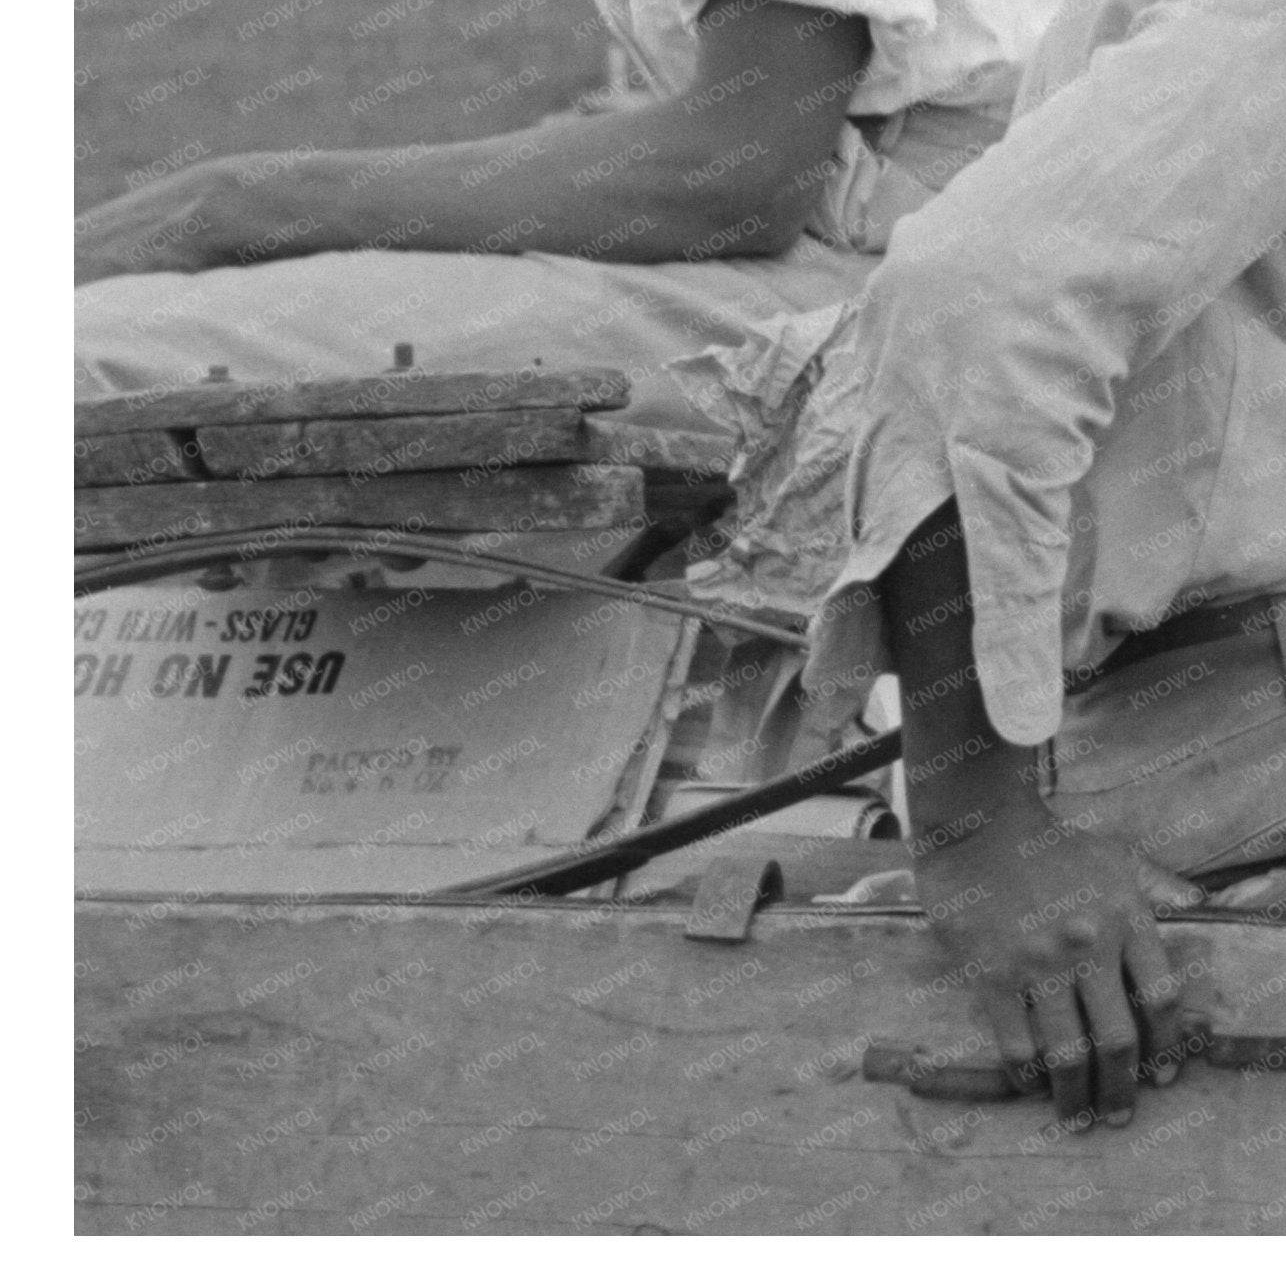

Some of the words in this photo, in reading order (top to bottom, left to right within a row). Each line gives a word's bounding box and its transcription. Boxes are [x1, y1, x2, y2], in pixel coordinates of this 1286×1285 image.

[116, 610, 198, 643] WITH
[220, 609, 318, 643] GLASS
[151, 653, 233, 700] NO
[243, 651, 346, 698] USE
